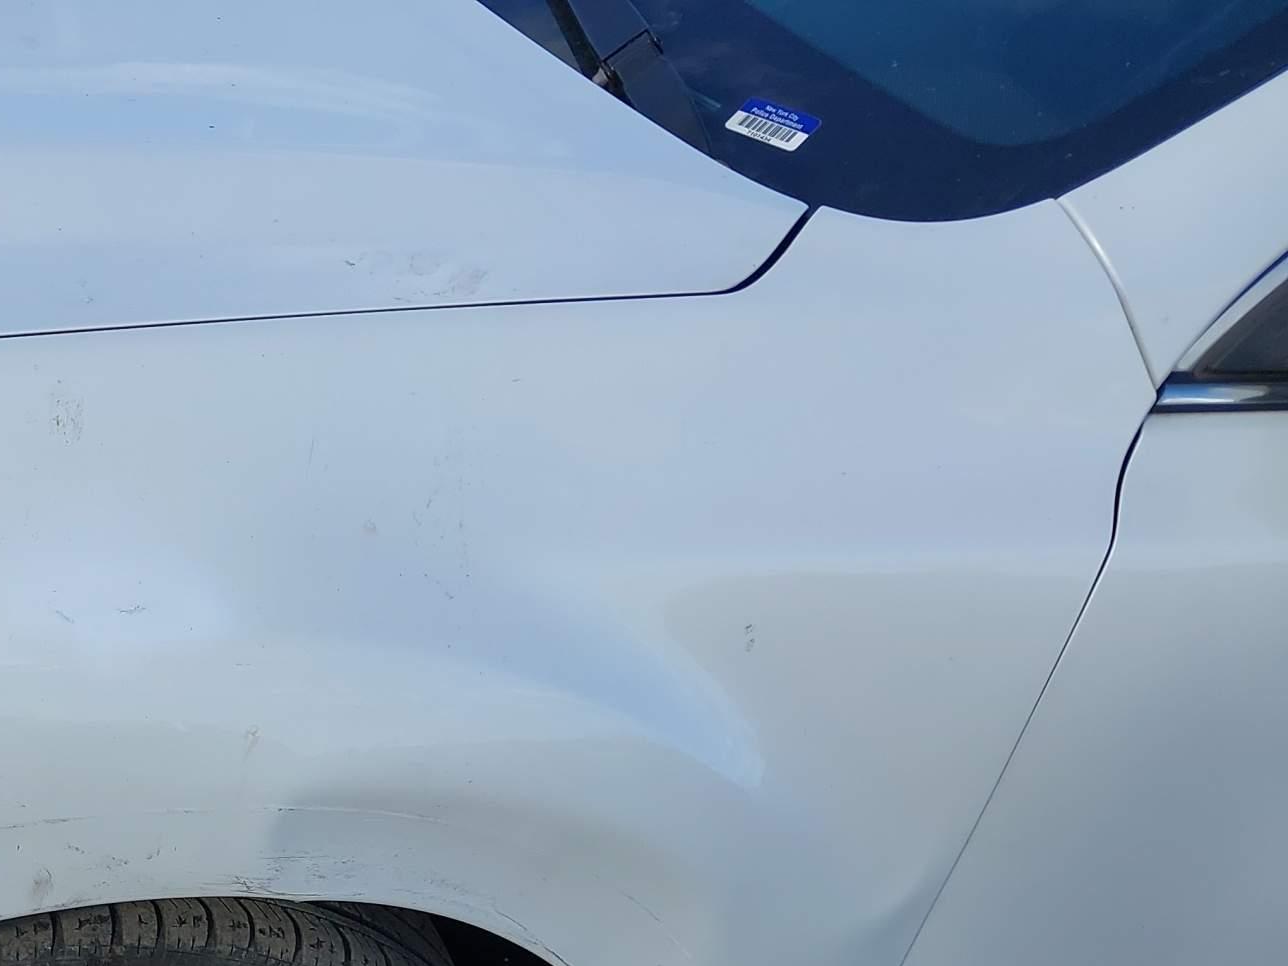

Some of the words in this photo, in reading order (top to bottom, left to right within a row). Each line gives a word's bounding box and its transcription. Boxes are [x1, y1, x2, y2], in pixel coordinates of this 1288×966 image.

[751, 107, 769, 118] Police
[769, 114, 804, 129] Department
[765, 105, 777, 113] New
[777, 109, 789, 117] York
[788, 113, 799, 121] City
